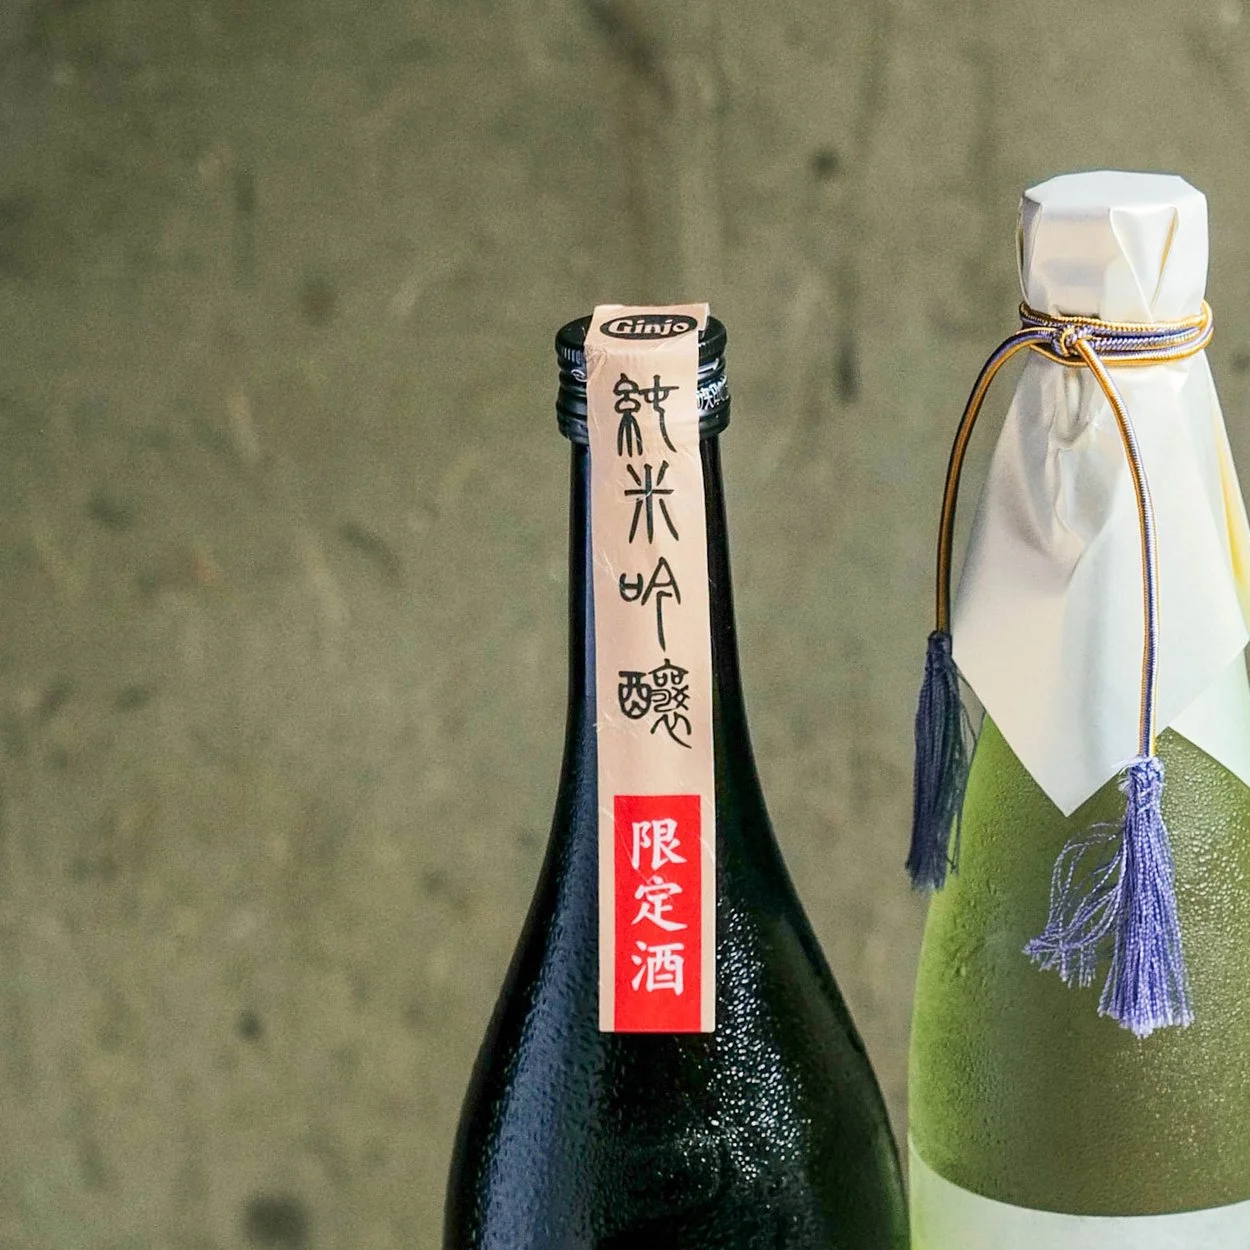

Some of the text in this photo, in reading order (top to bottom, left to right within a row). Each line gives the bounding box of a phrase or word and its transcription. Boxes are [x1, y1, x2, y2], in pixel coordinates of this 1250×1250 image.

[608, 319, 689, 335] Ginjo
[631, 818, 688, 996] 限定酒
